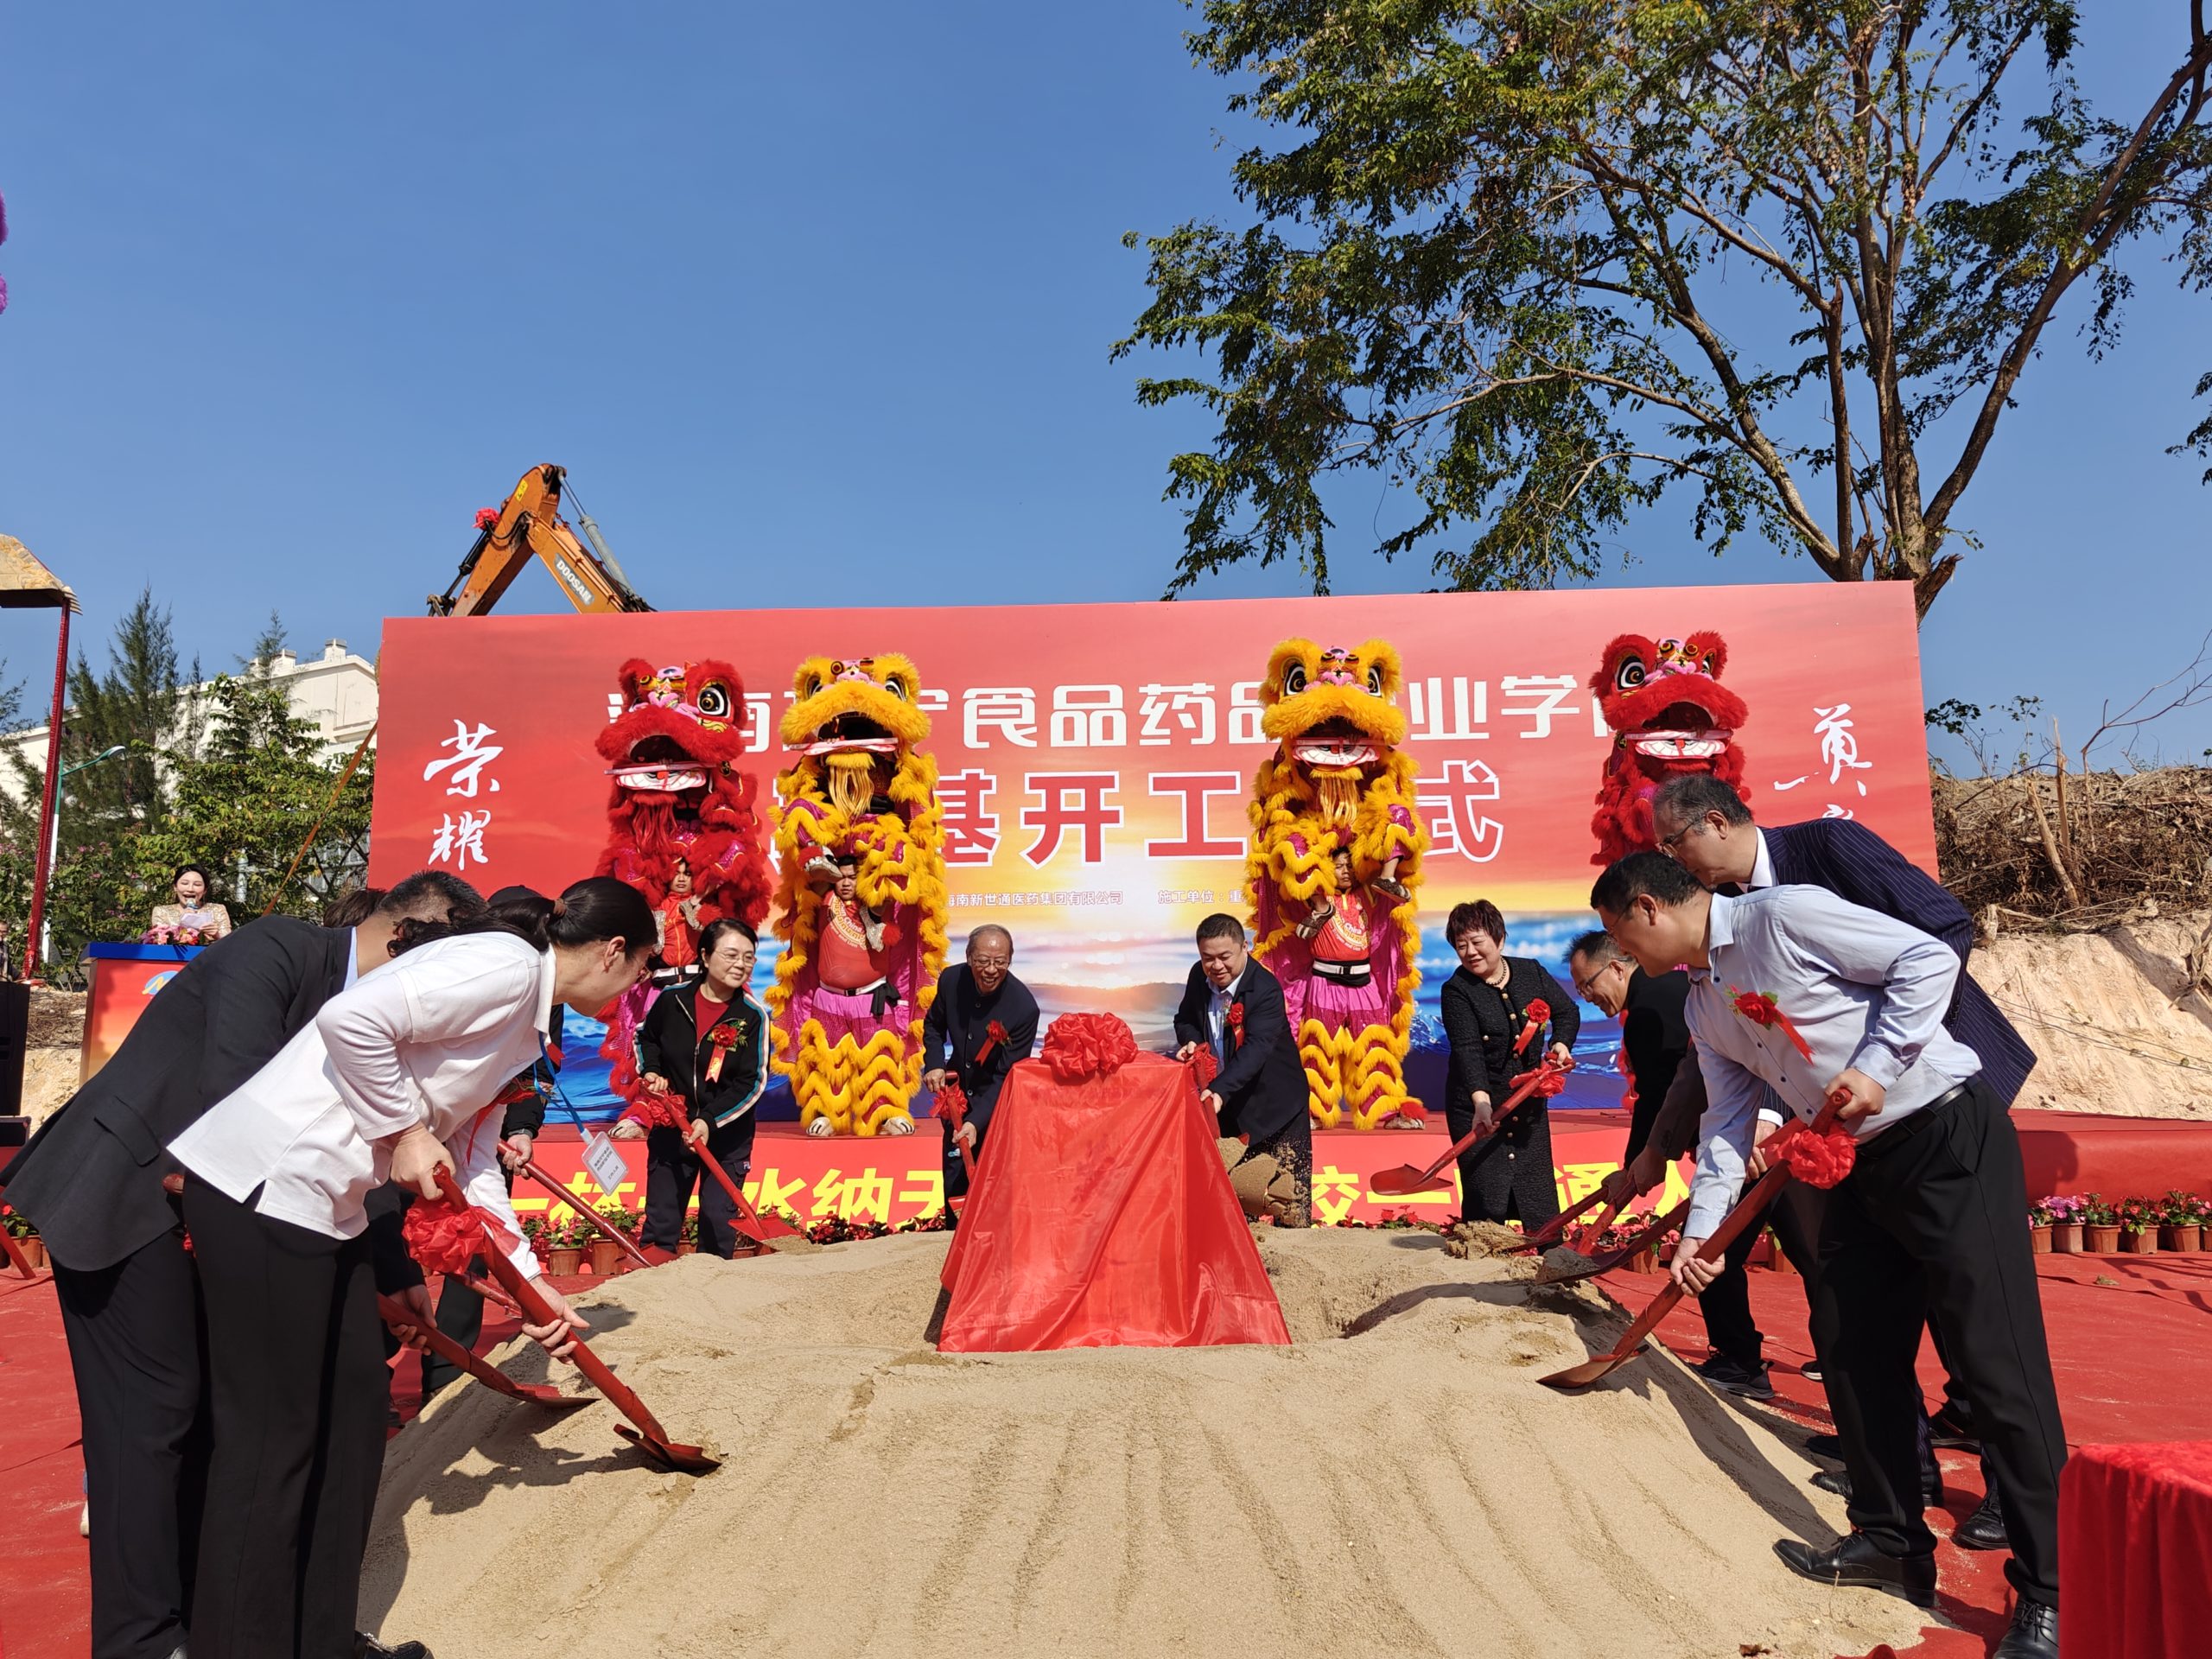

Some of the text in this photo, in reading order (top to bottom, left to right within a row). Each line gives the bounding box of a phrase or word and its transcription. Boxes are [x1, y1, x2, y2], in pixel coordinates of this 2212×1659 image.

[556, 560, 592, 605] DOOSAN
[423, 719, 504, 871] 荣耀
[1158, 890, 1247, 904] 施工单位：重
